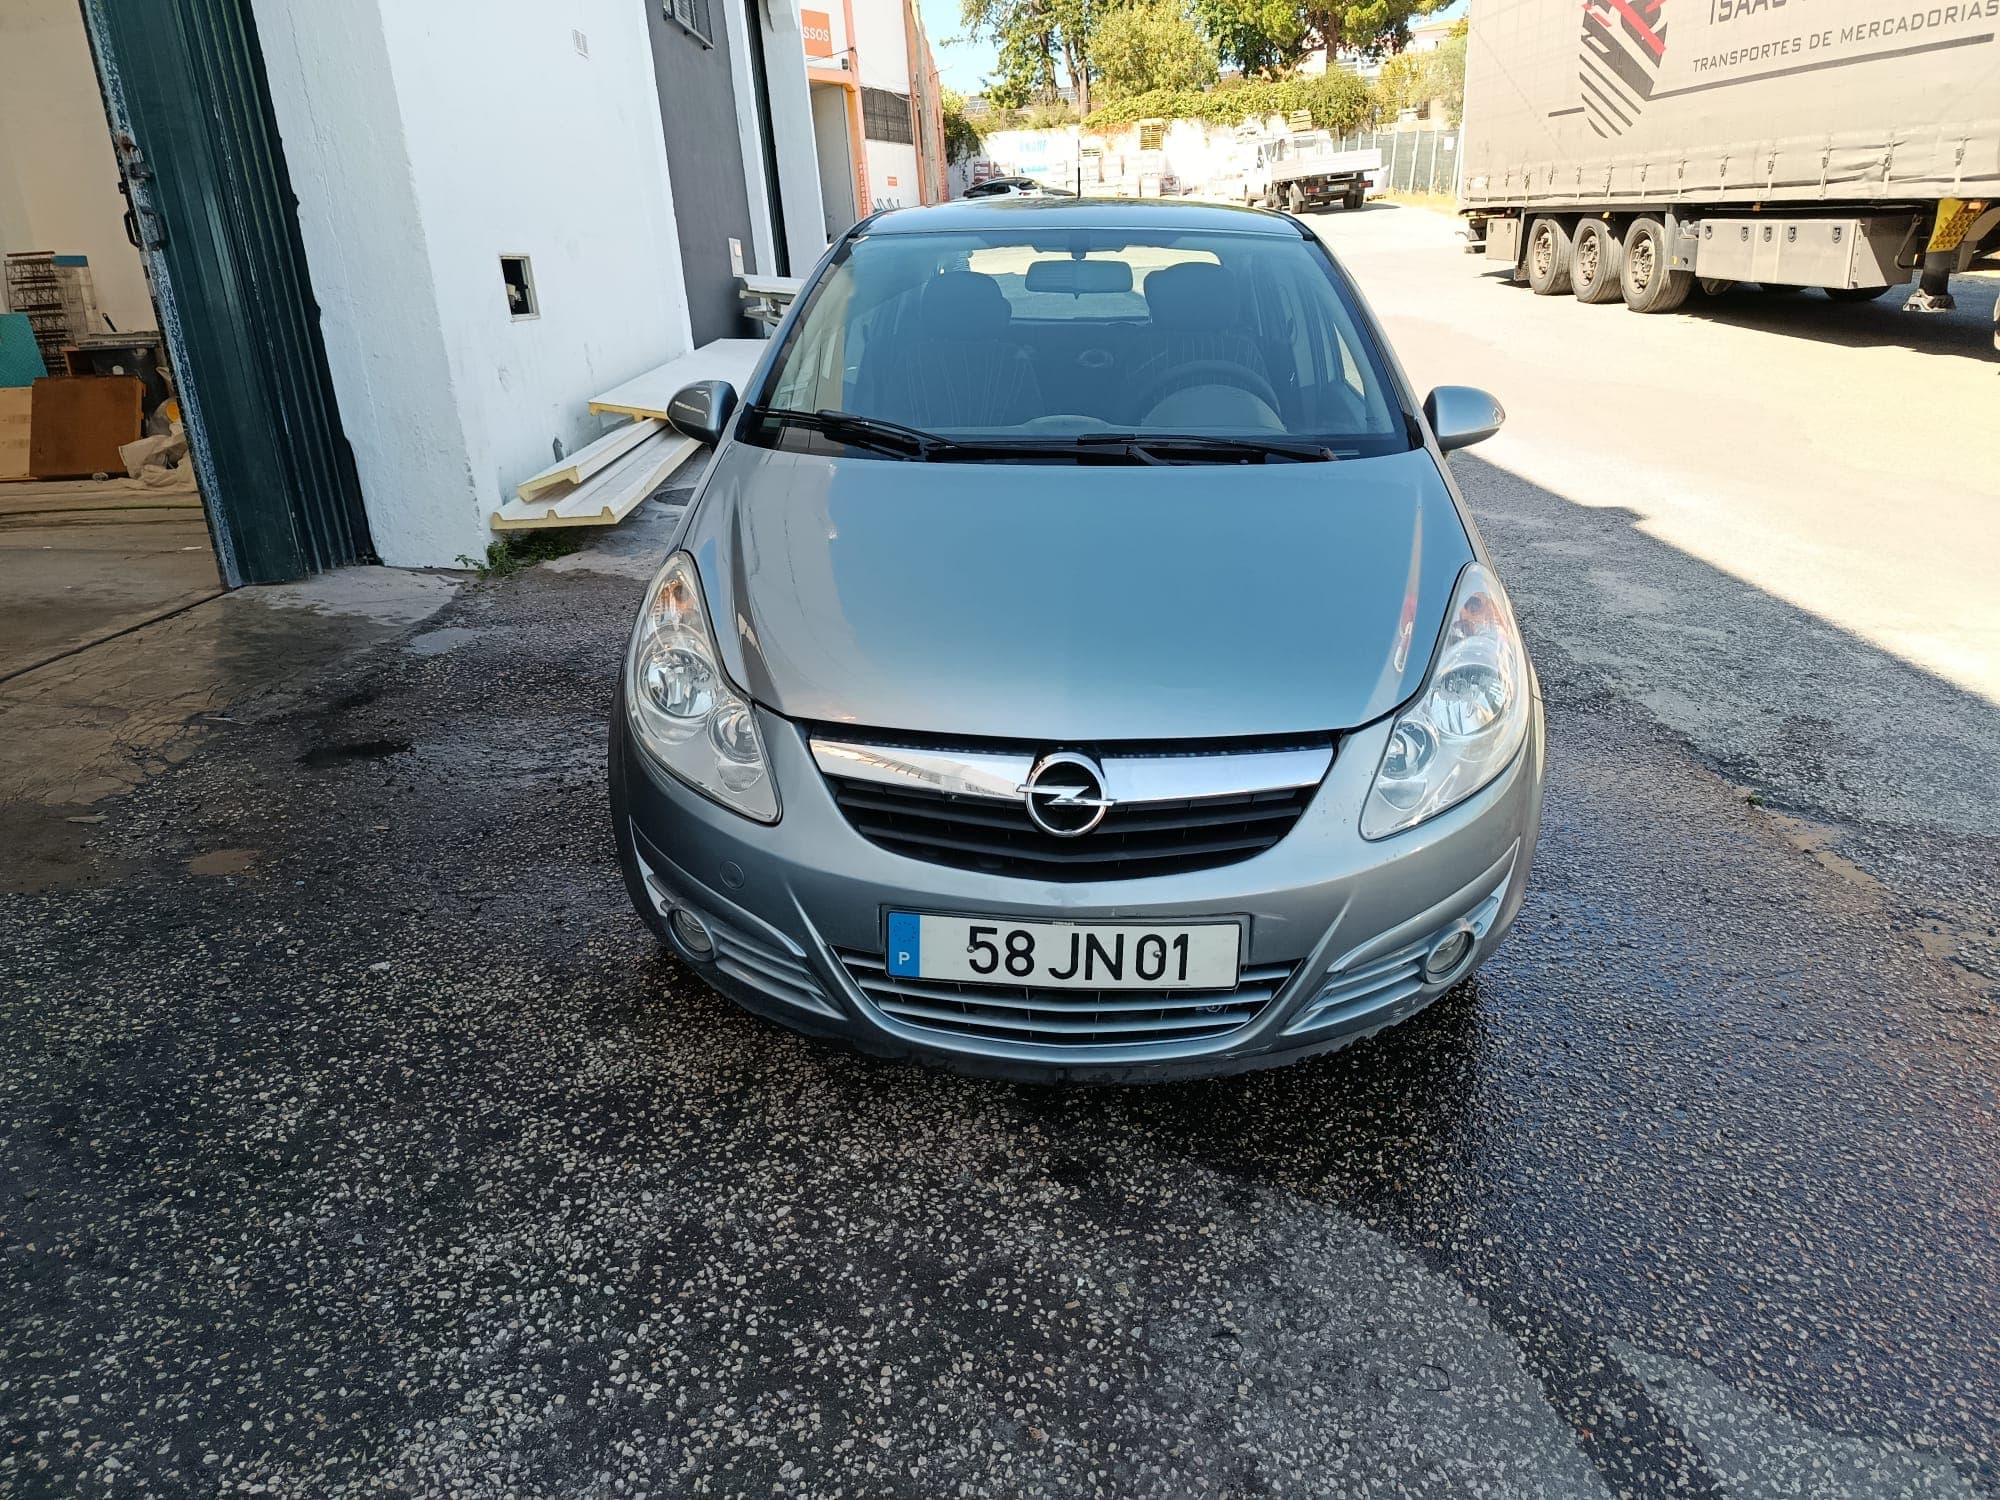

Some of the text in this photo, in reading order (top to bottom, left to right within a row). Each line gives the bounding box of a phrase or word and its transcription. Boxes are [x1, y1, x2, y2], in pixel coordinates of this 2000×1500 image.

[1692, 0, 2000, 73] TRANSPORTES DE MERCADORIAS
[1709, 0, 1787, 25] ISA
[898, 925, 1190, 982] P 58 JN 01
